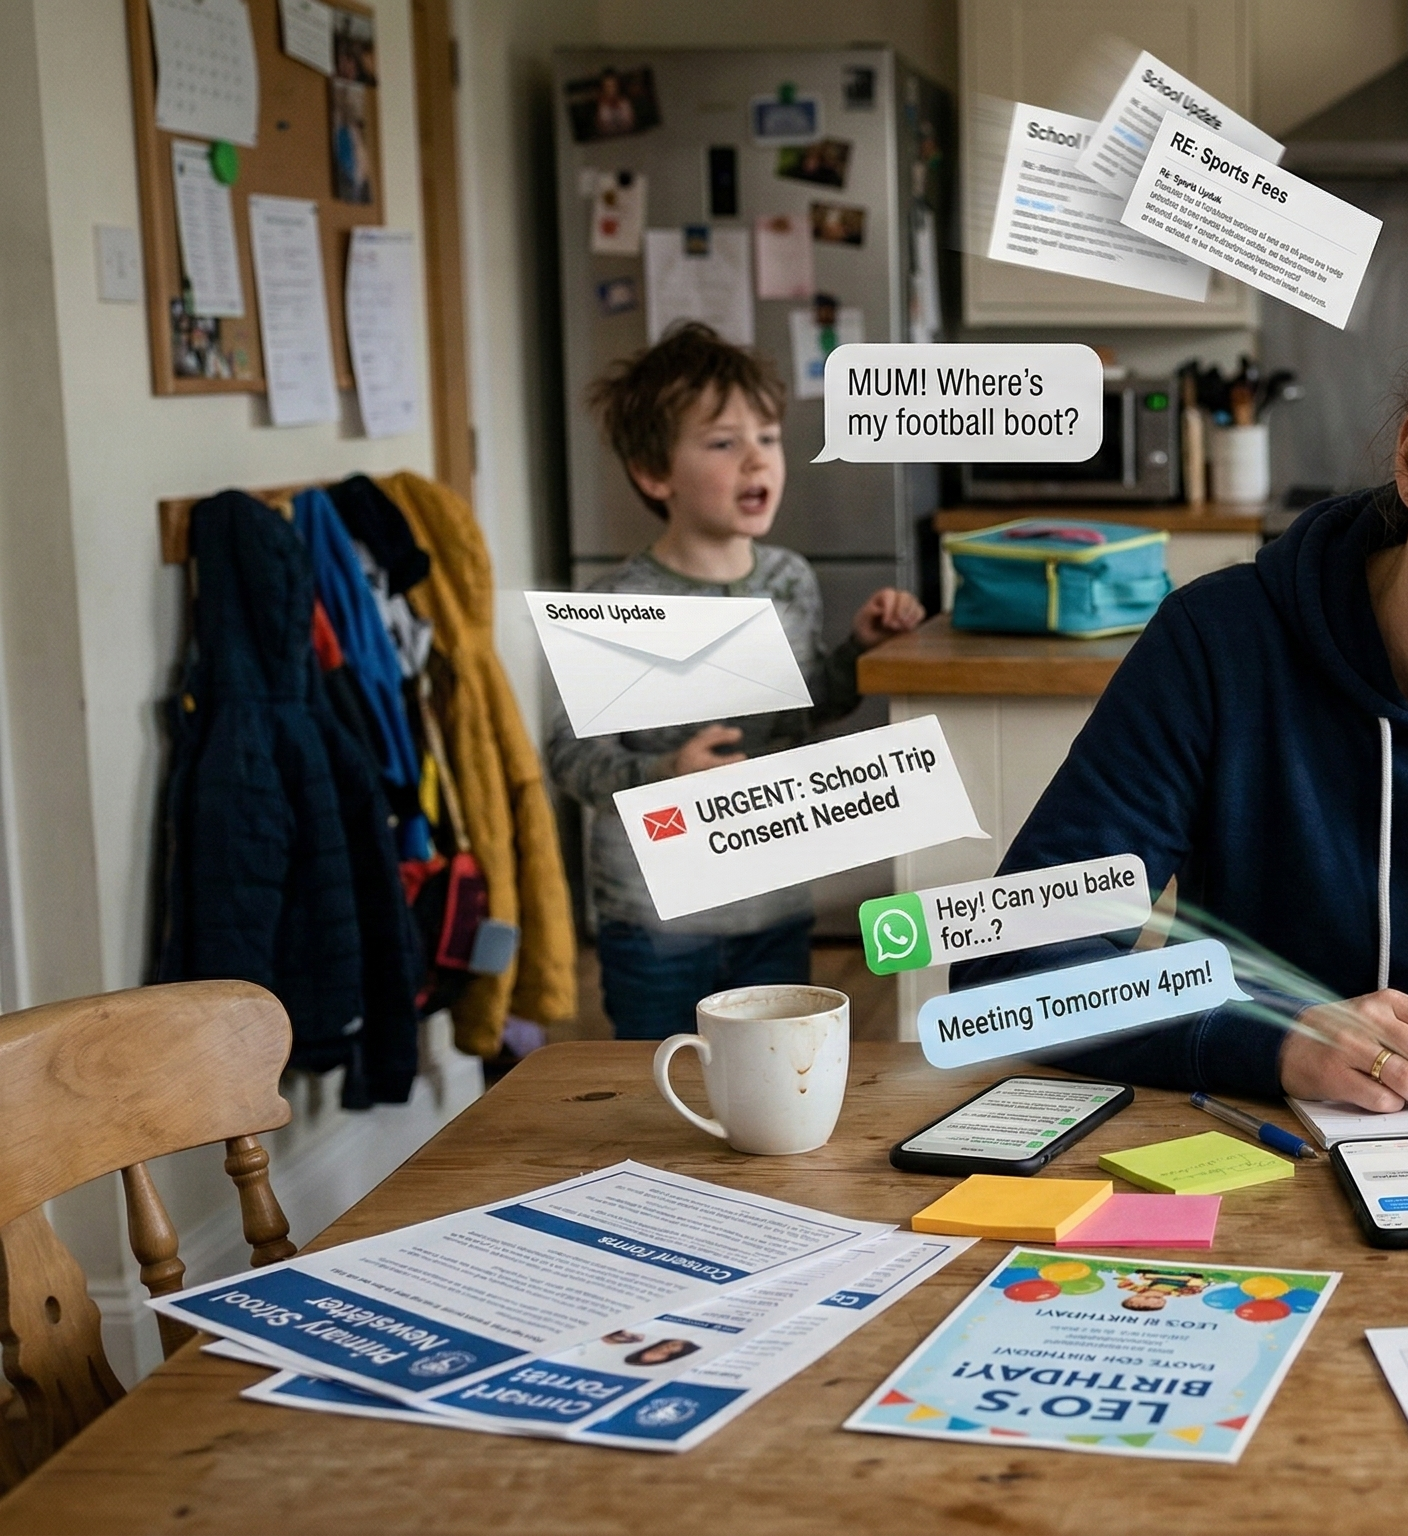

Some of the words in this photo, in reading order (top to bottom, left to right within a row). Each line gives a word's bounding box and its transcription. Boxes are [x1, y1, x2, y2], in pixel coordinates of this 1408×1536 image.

[293, 1320, 408, 1366] Primary
[303, 1296, 450, 1351] Newsletter
[951, 1360, 1214, 1397] BIRTHDAY!
[974, 1388, 1171, 1425] LEO’S
